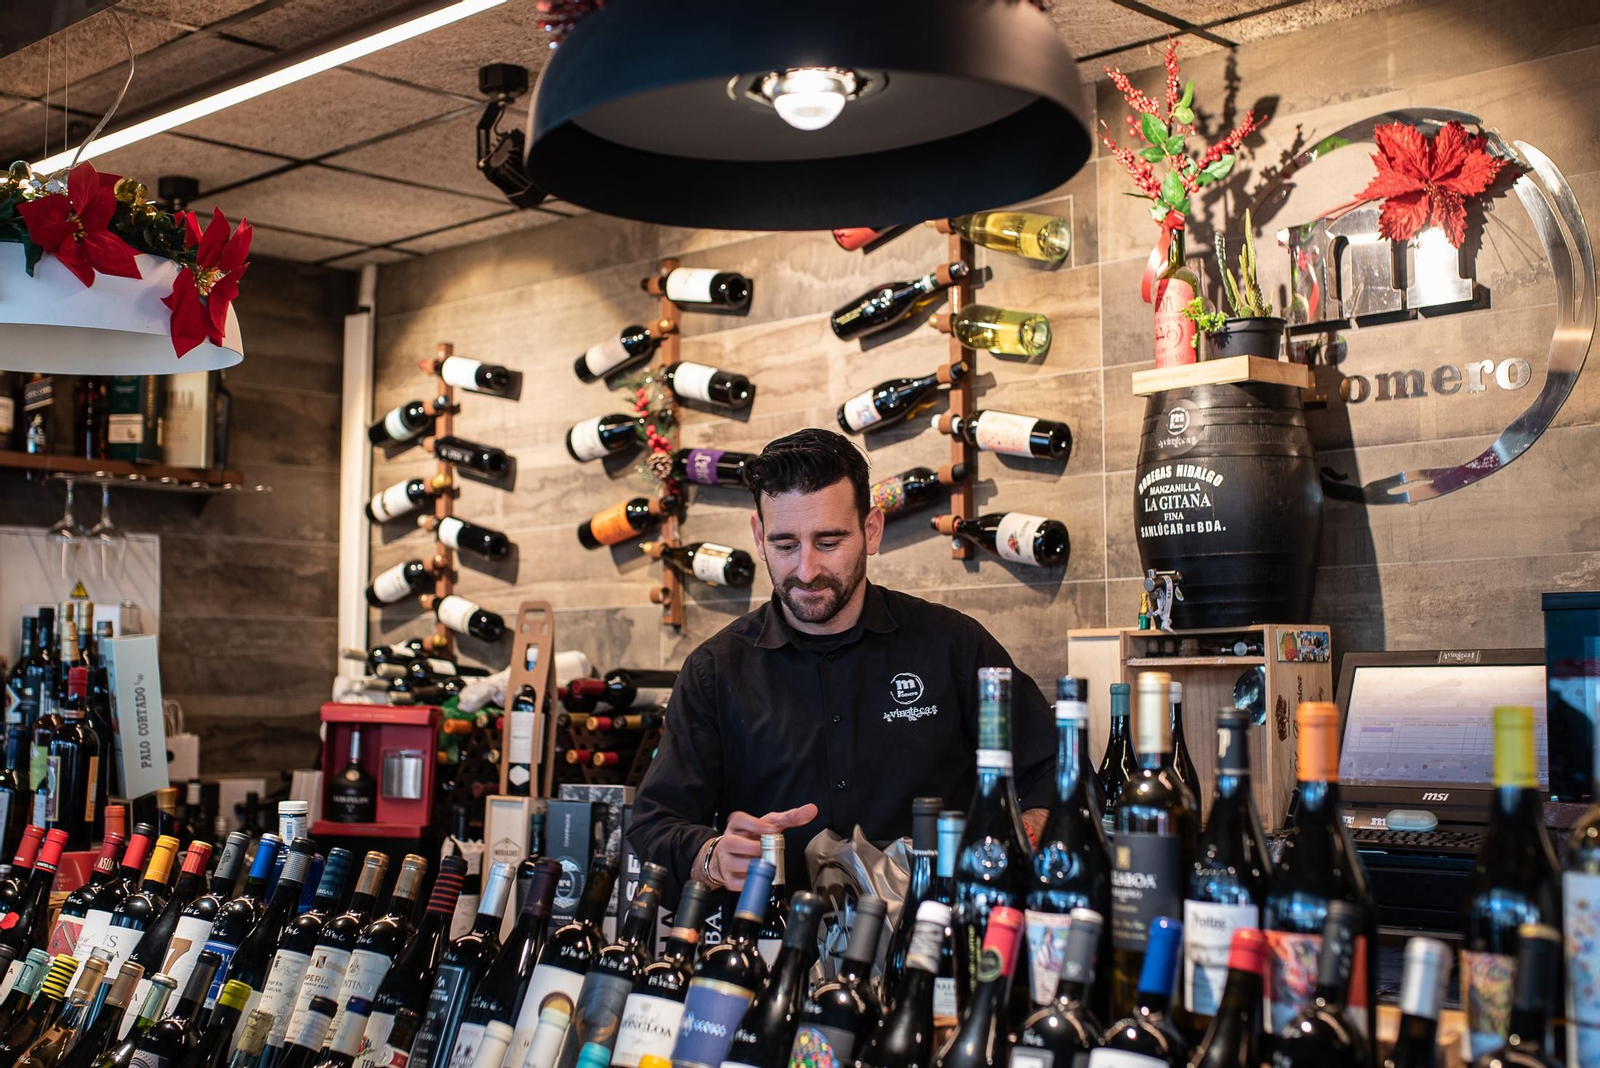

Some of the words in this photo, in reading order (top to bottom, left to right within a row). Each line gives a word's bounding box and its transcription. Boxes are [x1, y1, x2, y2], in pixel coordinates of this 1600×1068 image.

[1138, 465, 1173, 495] BODEGAS
[1175, 464, 1224, 487] HIDALGO
[1149, 482, 1201, 496] MANZANILLA
[1144, 497, 1158, 512] LA
[1159, 492, 1212, 511] GITANA
[1163, 511, 1184, 522] FINA
[1140, 522, 1184, 539] SANLÚCAR
[1186, 523, 1196, 532] DE
[1197, 519, 1227, 533] BDA.
[895, 679, 916, 690] m
[135, 687, 148, 738] CORTADO
[140, 740, 151, 768] PALO
[1422, 792, 1449, 801] msi
